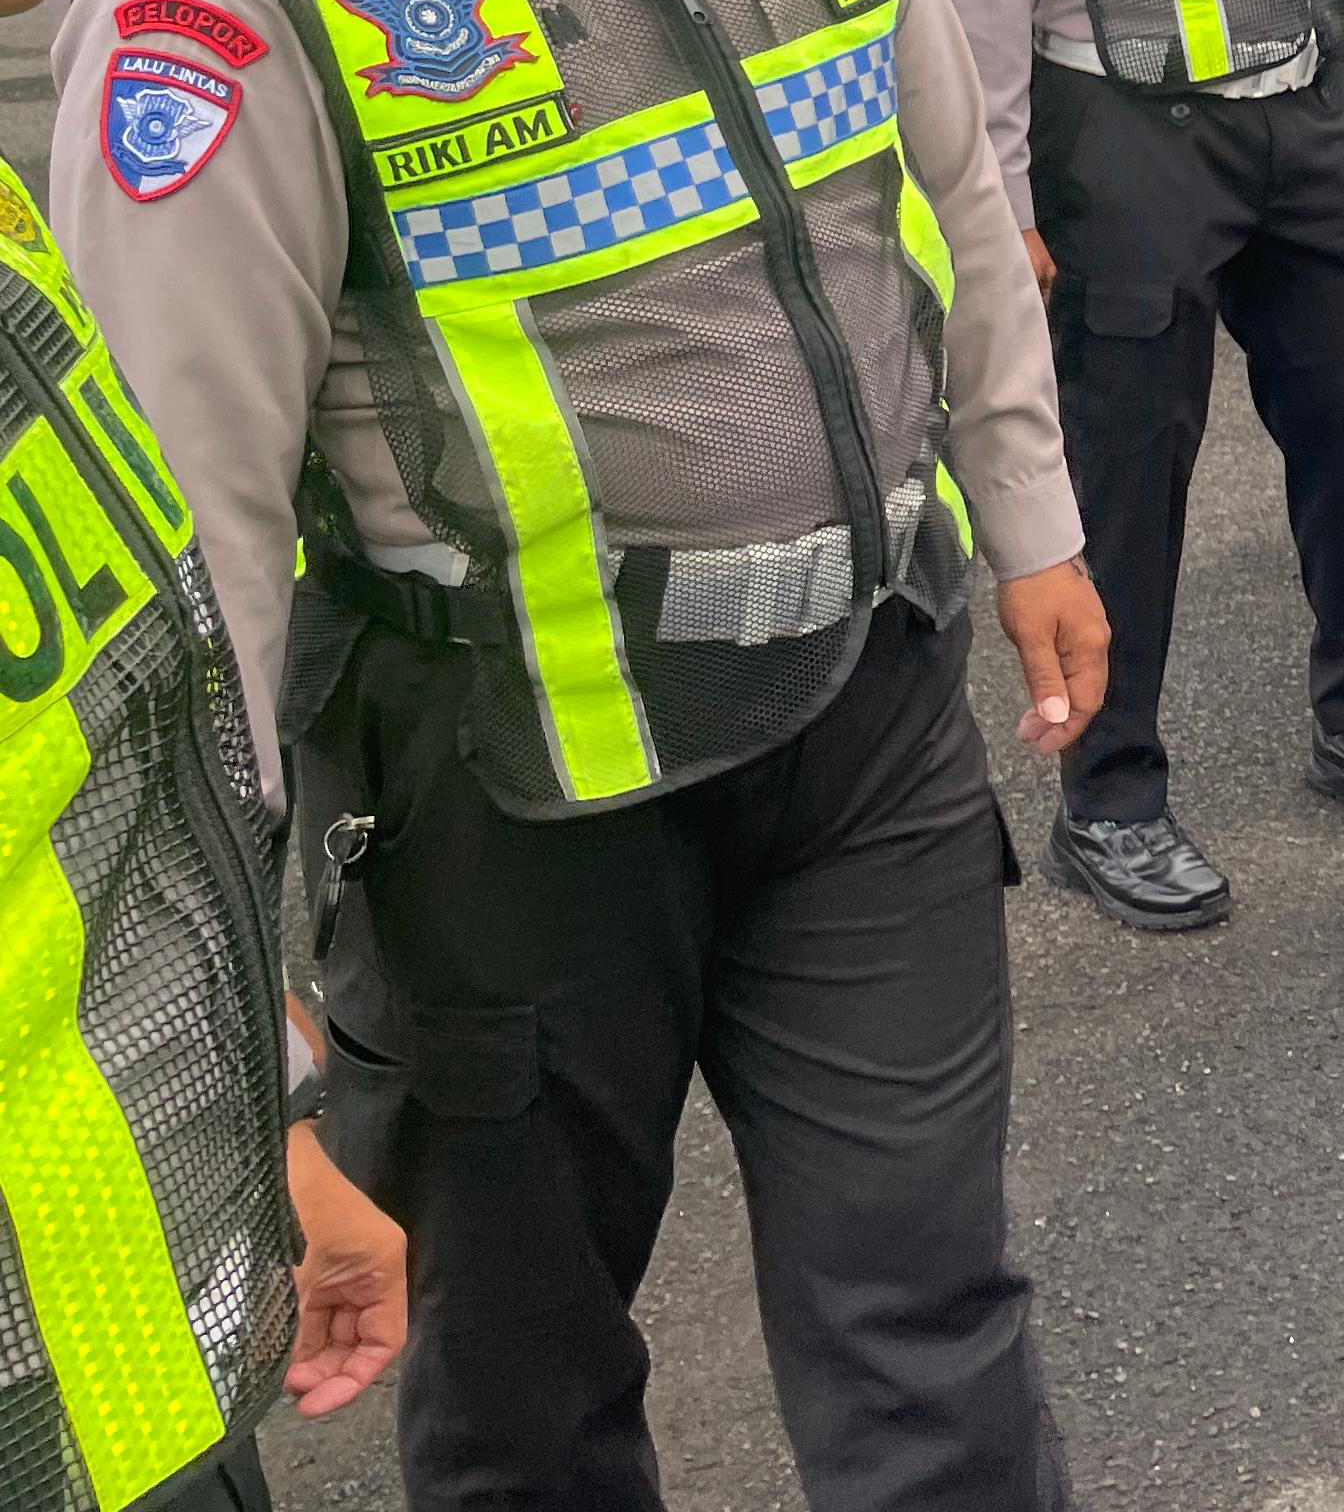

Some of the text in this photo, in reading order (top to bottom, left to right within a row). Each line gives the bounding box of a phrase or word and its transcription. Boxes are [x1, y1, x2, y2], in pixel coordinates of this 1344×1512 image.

[127, 0, 252, 60] PELOPOR
[123, 57, 229, 98] LALU LINTAS
[386, 108, 554, 182] RIKI AM
